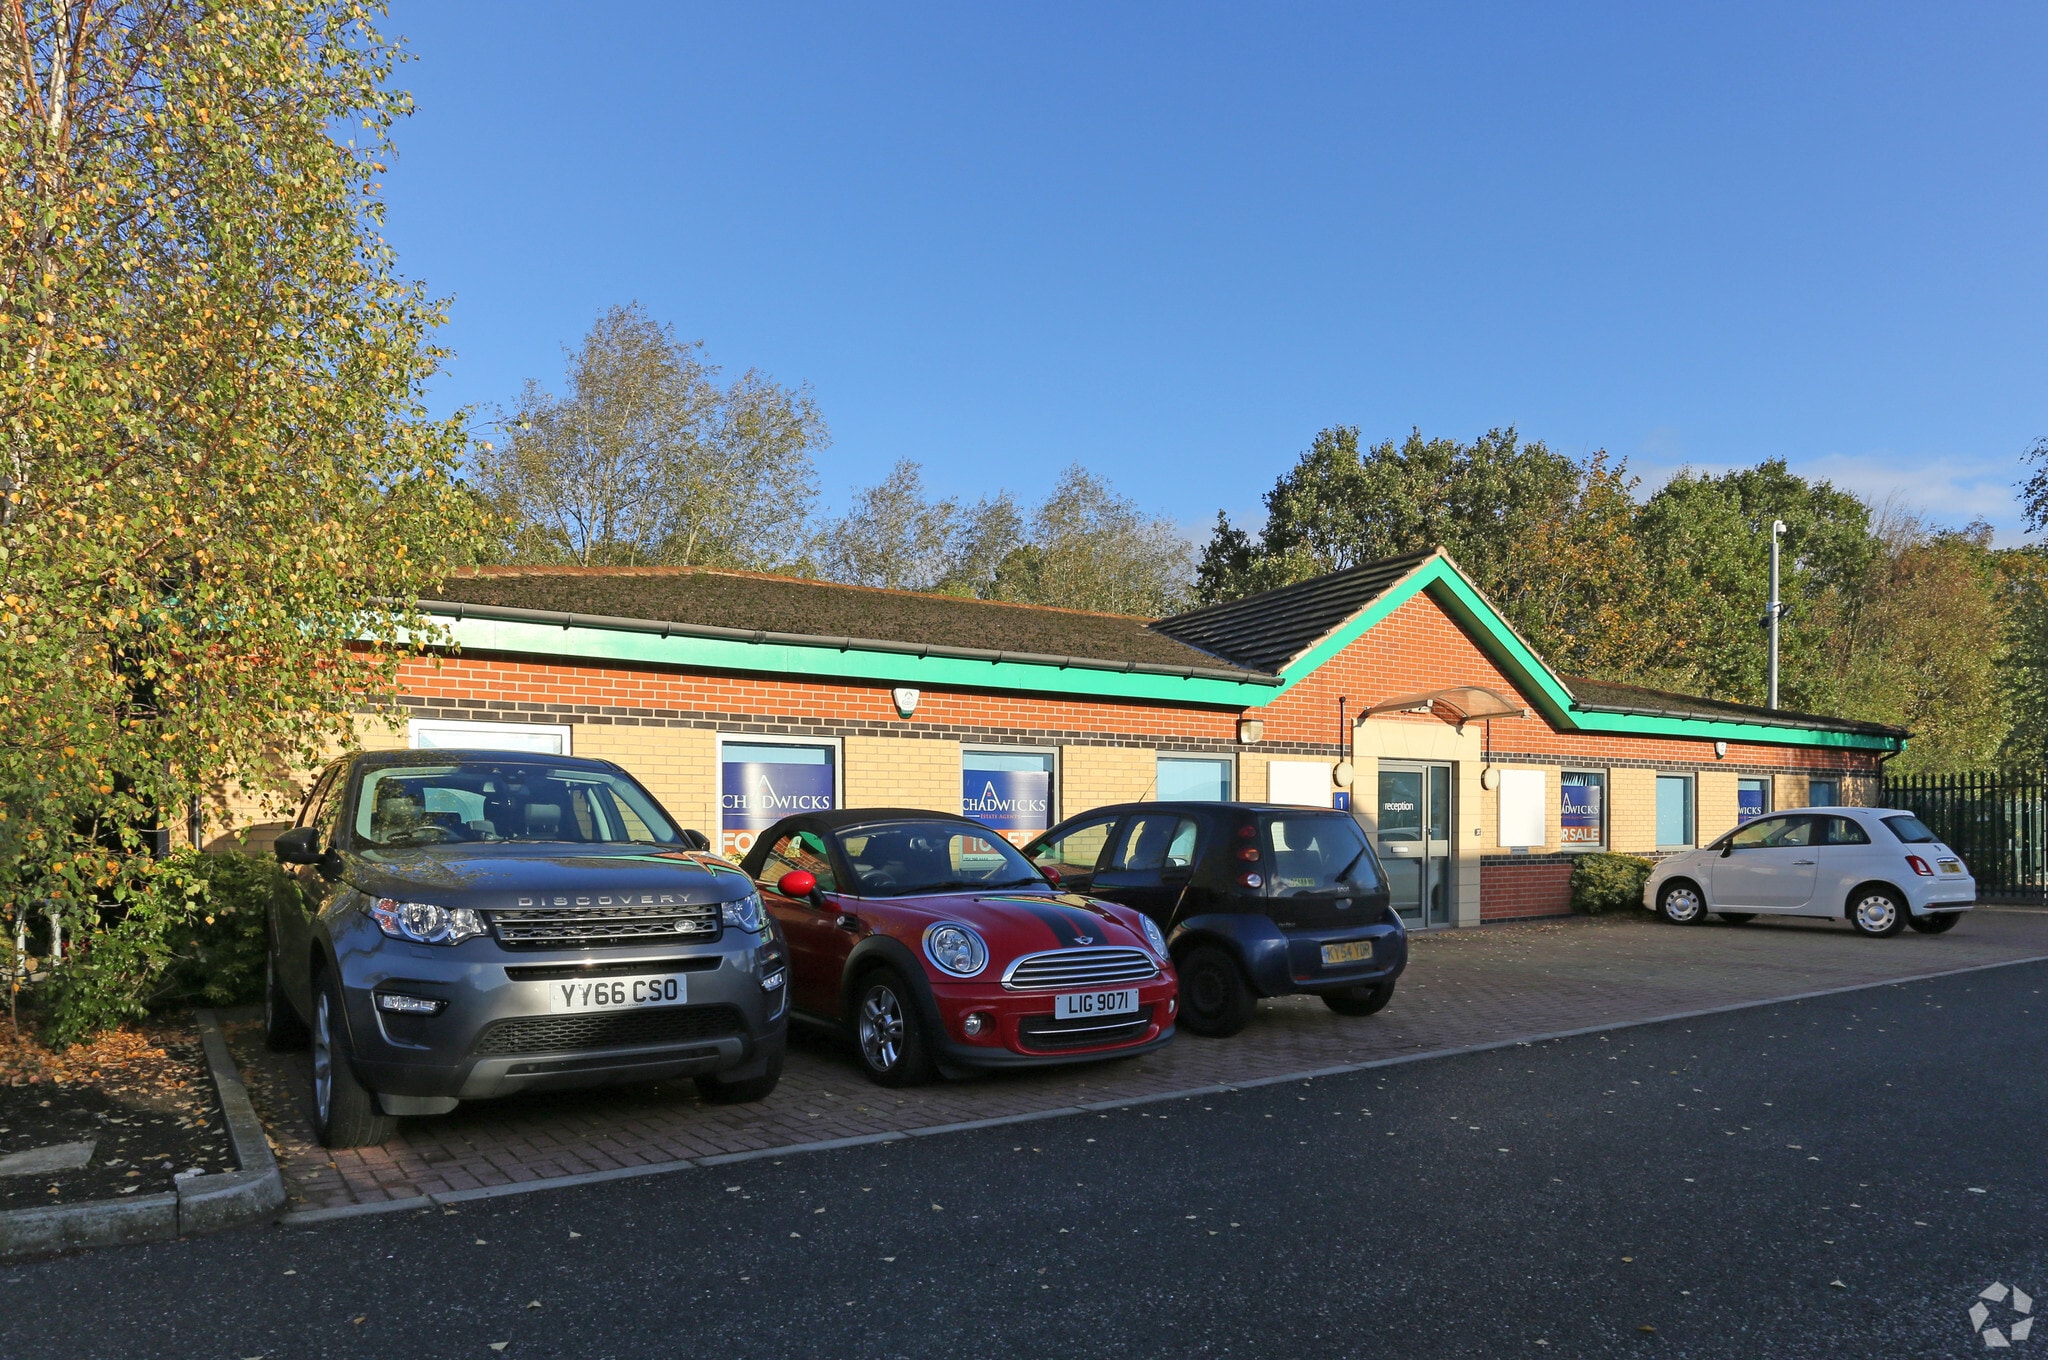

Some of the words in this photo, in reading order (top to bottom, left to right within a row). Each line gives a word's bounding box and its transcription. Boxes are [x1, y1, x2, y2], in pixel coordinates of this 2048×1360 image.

[962, 780, 1046, 812] CHADWICKS
[1338, 796, 1344, 809] 1
[1384, 801, 1414, 812] reception
[1570, 828, 1599, 841] SALE
[518, 894, 692, 907] DISCOVERY
[561, 982, 626, 1008] YY66
[633, 978, 678, 1003] CSO
[1068, 993, 1093, 1014] LIG
[1097, 991, 1128, 1011] 9071
